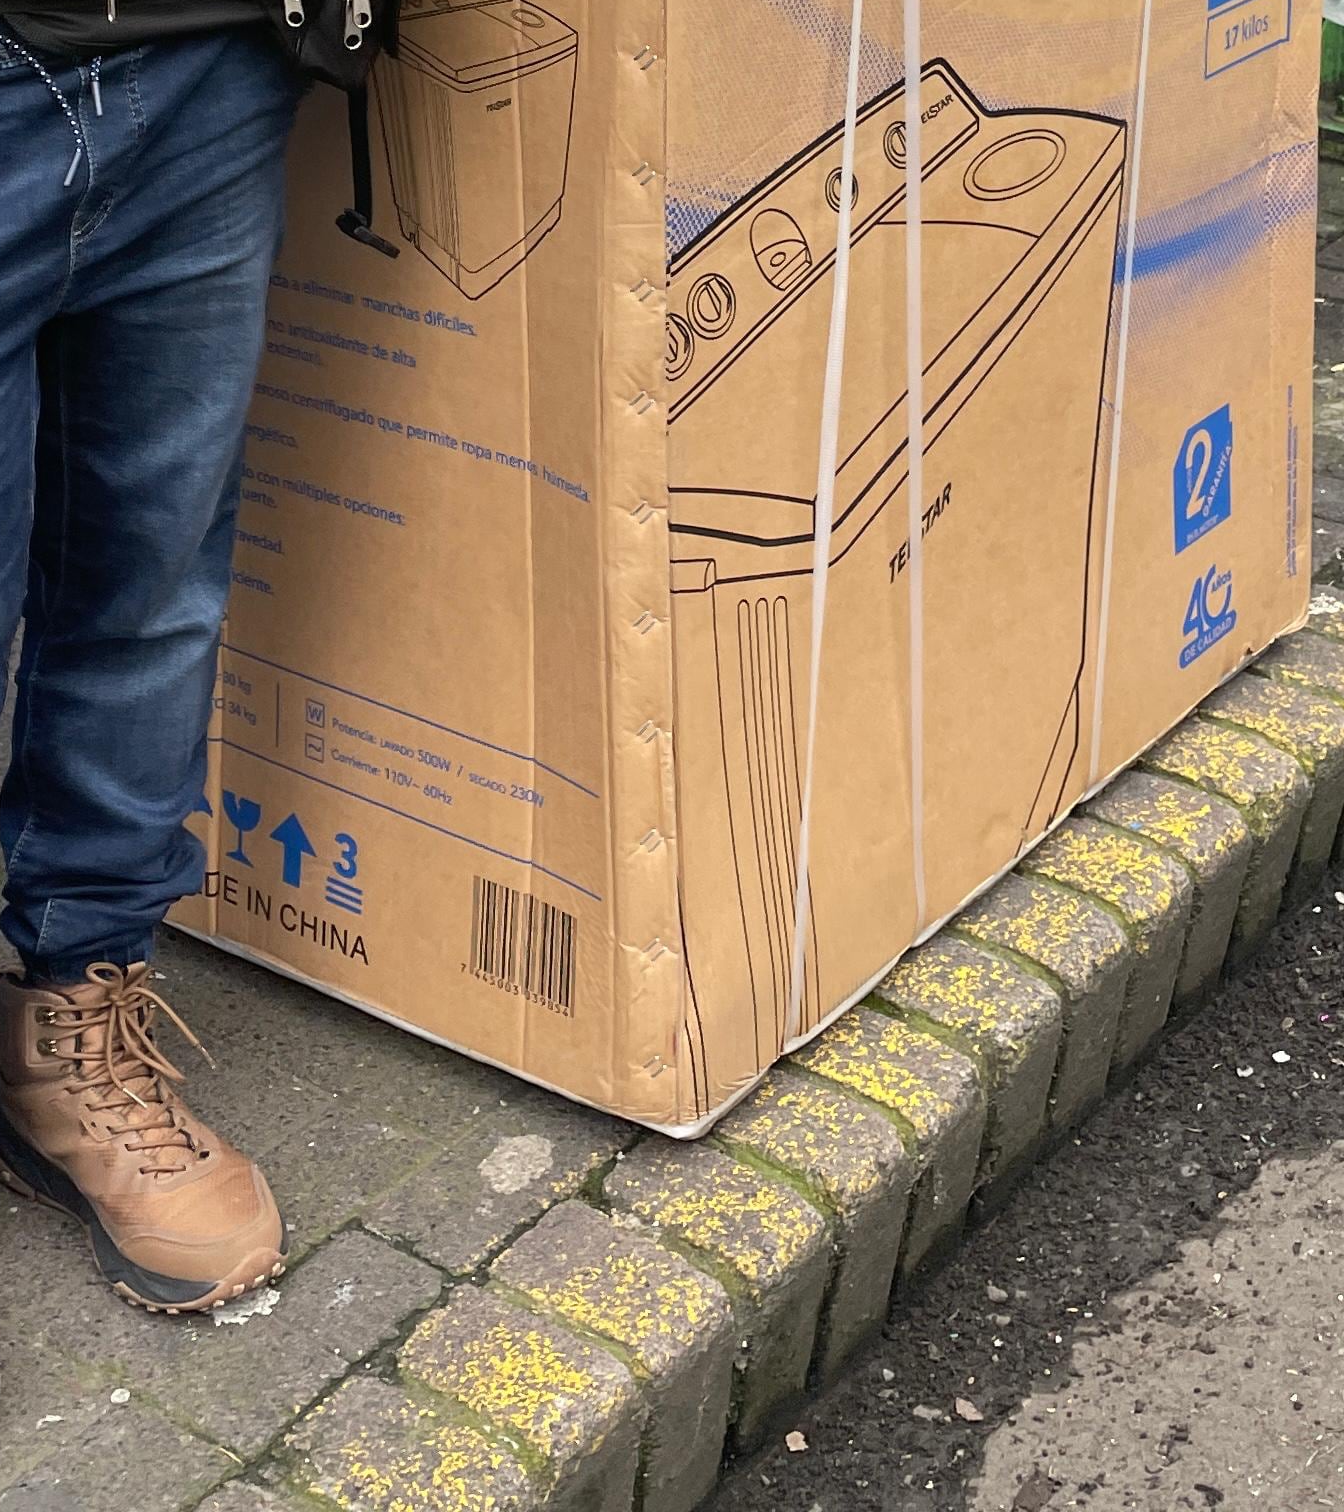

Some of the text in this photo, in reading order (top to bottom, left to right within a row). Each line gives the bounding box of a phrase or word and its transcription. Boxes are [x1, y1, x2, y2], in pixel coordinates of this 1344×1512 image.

[1224, 14, 1269, 50] 17 kilos
[921, 94, 954, 124] ELSTAR
[361, 296, 421, 322] manchas
[392, 349, 416, 368] alta
[291, 393, 375, 425] centrifugado
[378, 417, 404, 434] que
[406, 425, 458, 451] permite
[462, 440, 492, 461] ropa
[256, 471, 280, 487] con
[1185, 428, 1212, 520] 2
[241, 488, 278, 509] uerte.
[1184, 616, 1233, 663] DE CALIDAD
[417, 749, 452, 773] 500W
[332, 832, 359, 879] 3
[205, 871, 369, 966] DE IN CHINA
